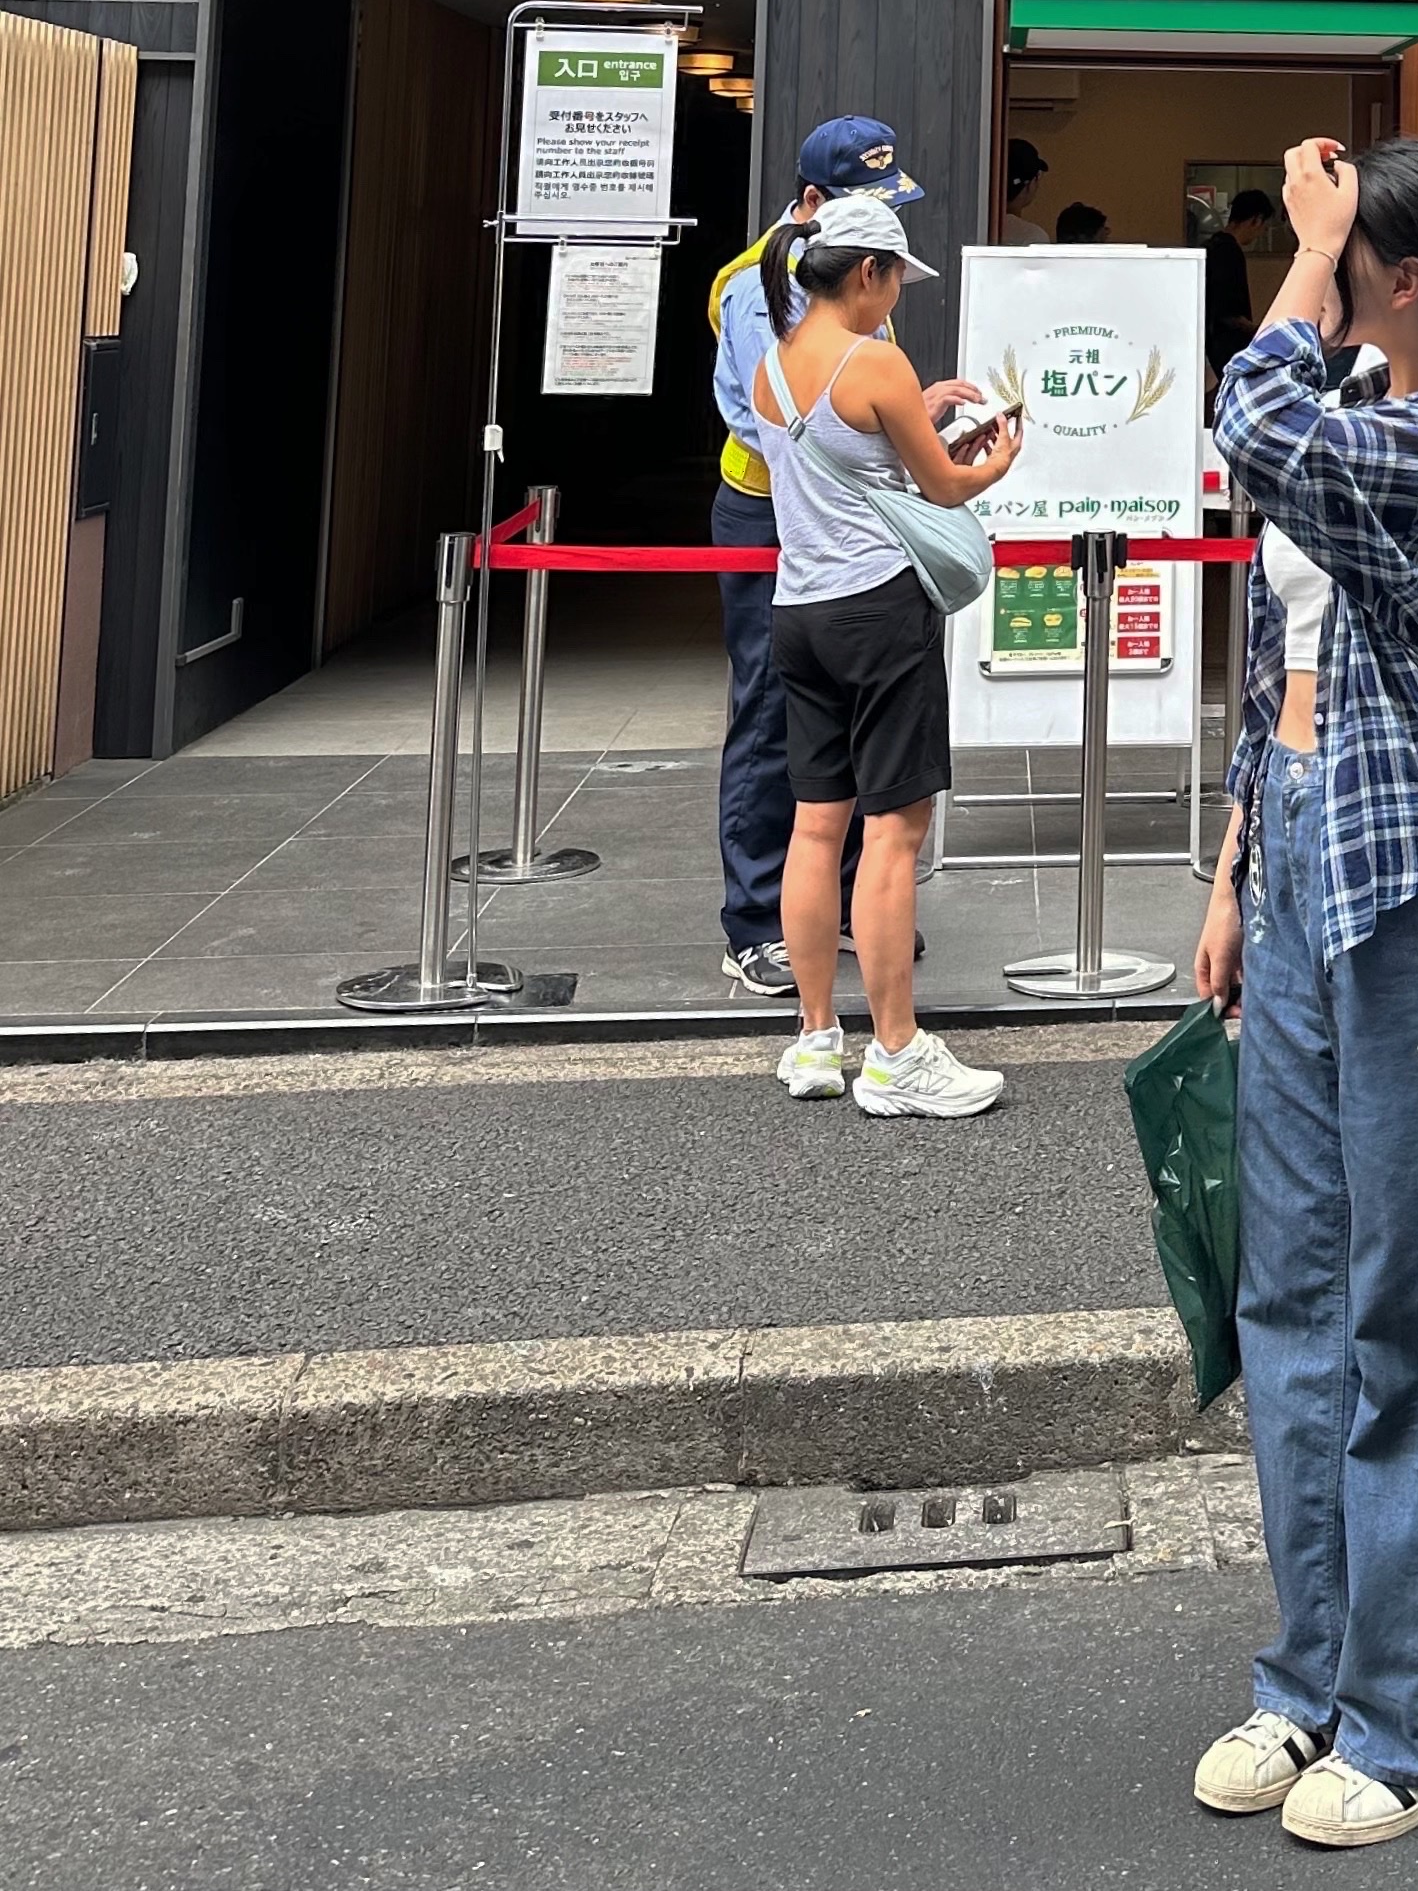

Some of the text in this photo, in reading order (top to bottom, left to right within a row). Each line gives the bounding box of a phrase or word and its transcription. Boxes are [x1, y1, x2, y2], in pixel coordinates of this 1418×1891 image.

[554, 58, 599, 79] 入口
[603, 59, 658, 70] entrance
[618, 69, 641, 82] 입구
[548, 110, 649, 123] 受付番号をスタッフへ
[564, 122, 632, 134] お見せください
[537, 138, 567, 146] Please
[596, 140, 616, 148] your
[618, 138, 650, 149] receipt
[604, 147, 626, 155] staff
[1053, 326, 1115, 339] PREMIUM
[1068, 348, 1101, 364] 元祖
[1041, 369, 1128, 397] 塩パン
[1053, 423, 1108, 437] QUALITY
[973, 499, 1049, 518] 塩パン屋
